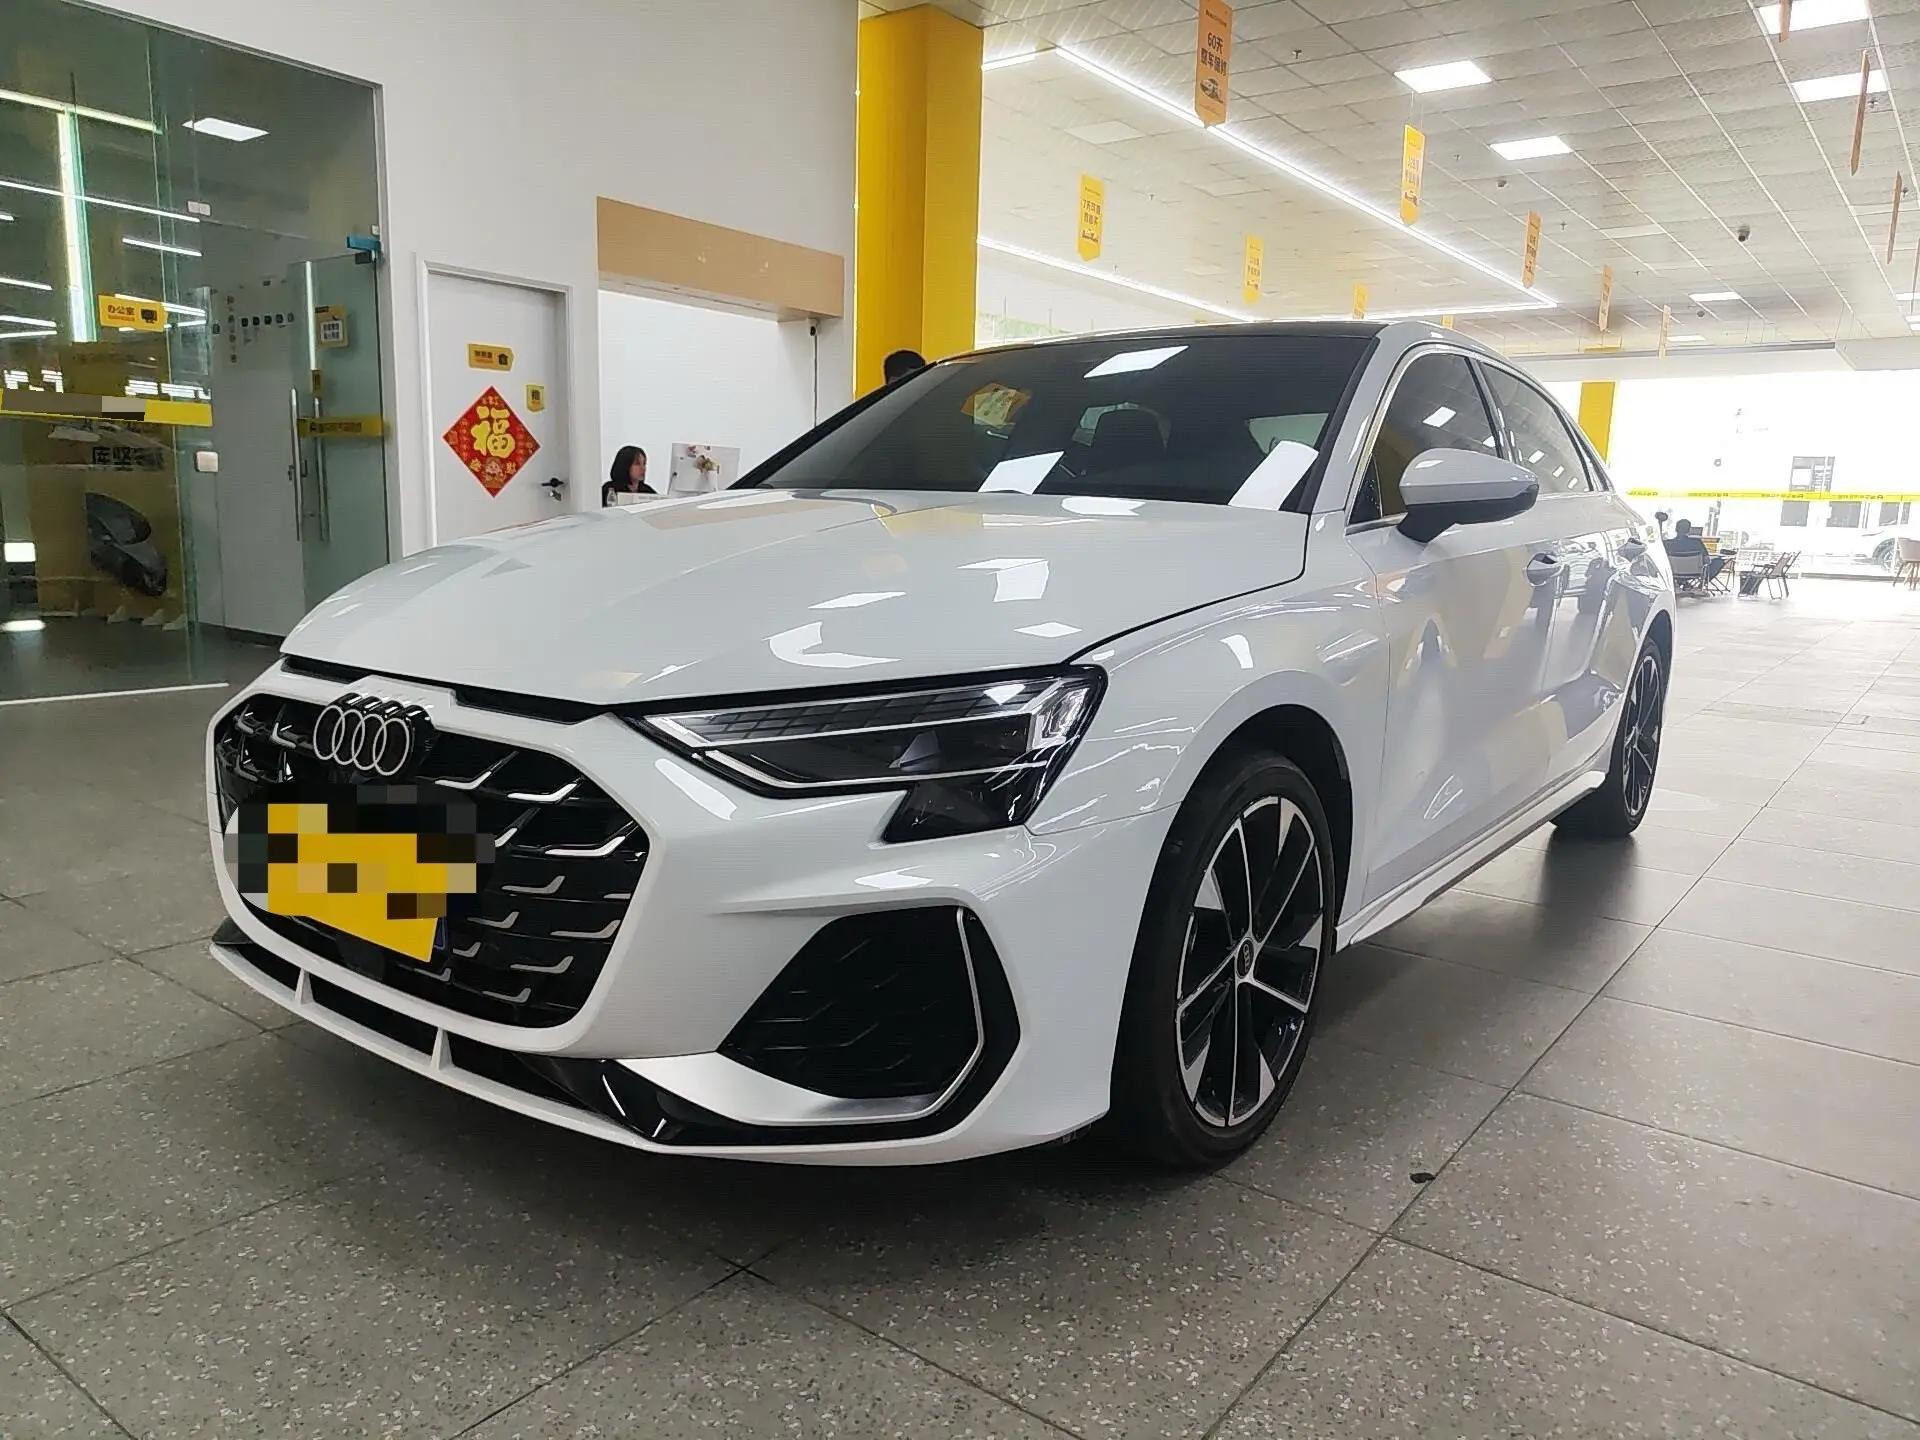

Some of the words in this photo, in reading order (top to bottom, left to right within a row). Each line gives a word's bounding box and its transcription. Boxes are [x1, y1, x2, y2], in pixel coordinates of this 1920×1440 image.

[1207, 32, 1224, 54] 60天
[107, 304, 136, 316] 办公室
[470, 405, 516, 459] 福
